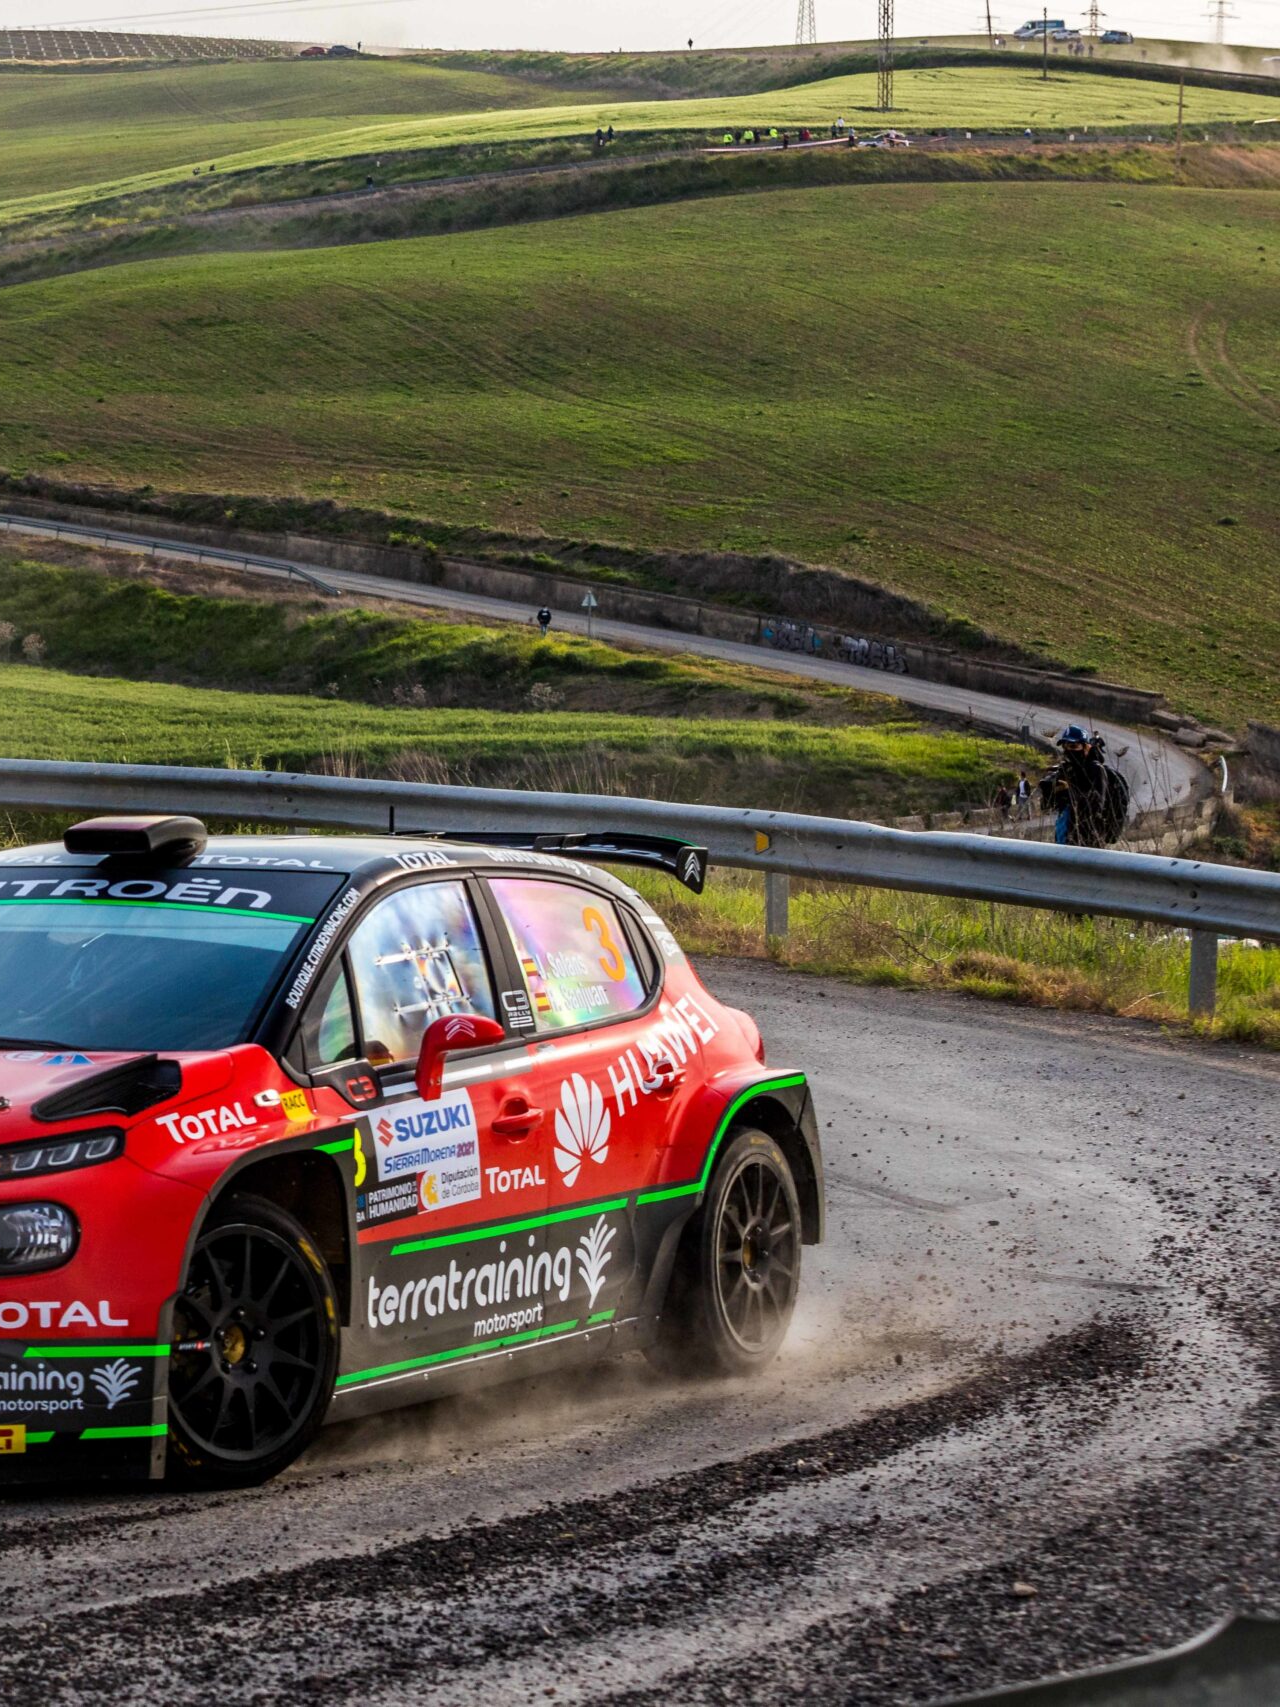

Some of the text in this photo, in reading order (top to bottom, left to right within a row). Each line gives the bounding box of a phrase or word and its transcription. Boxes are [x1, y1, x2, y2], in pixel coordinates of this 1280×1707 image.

[193, 854, 335, 870] TOTAL
[385, 851, 458, 870] TOTAL
[285, 887, 361, 1010] BOUTIQUE.CITROENRACING.COM
[582, 906, 626, 982] 3
[607, 992, 720, 1117] HUAWEI
[282, 1094, 306, 1110] RACC
[156, 1101, 258, 1144] TOTAL
[394, 1103, 471, 1142] SUZUKI
[441, 1166, 479, 1185] Diputación
[441, 1180, 479, 1200] de Córdoba
[485, 1165, 546, 1194] TOTAL
[368, 1181, 412, 1202] PATRIMONIO
[369, 1193, 419, 1219] HUMANIDAD
[367, 1234, 572, 1329] terratraining
[473, 1302, 544, 1338] motorsport
